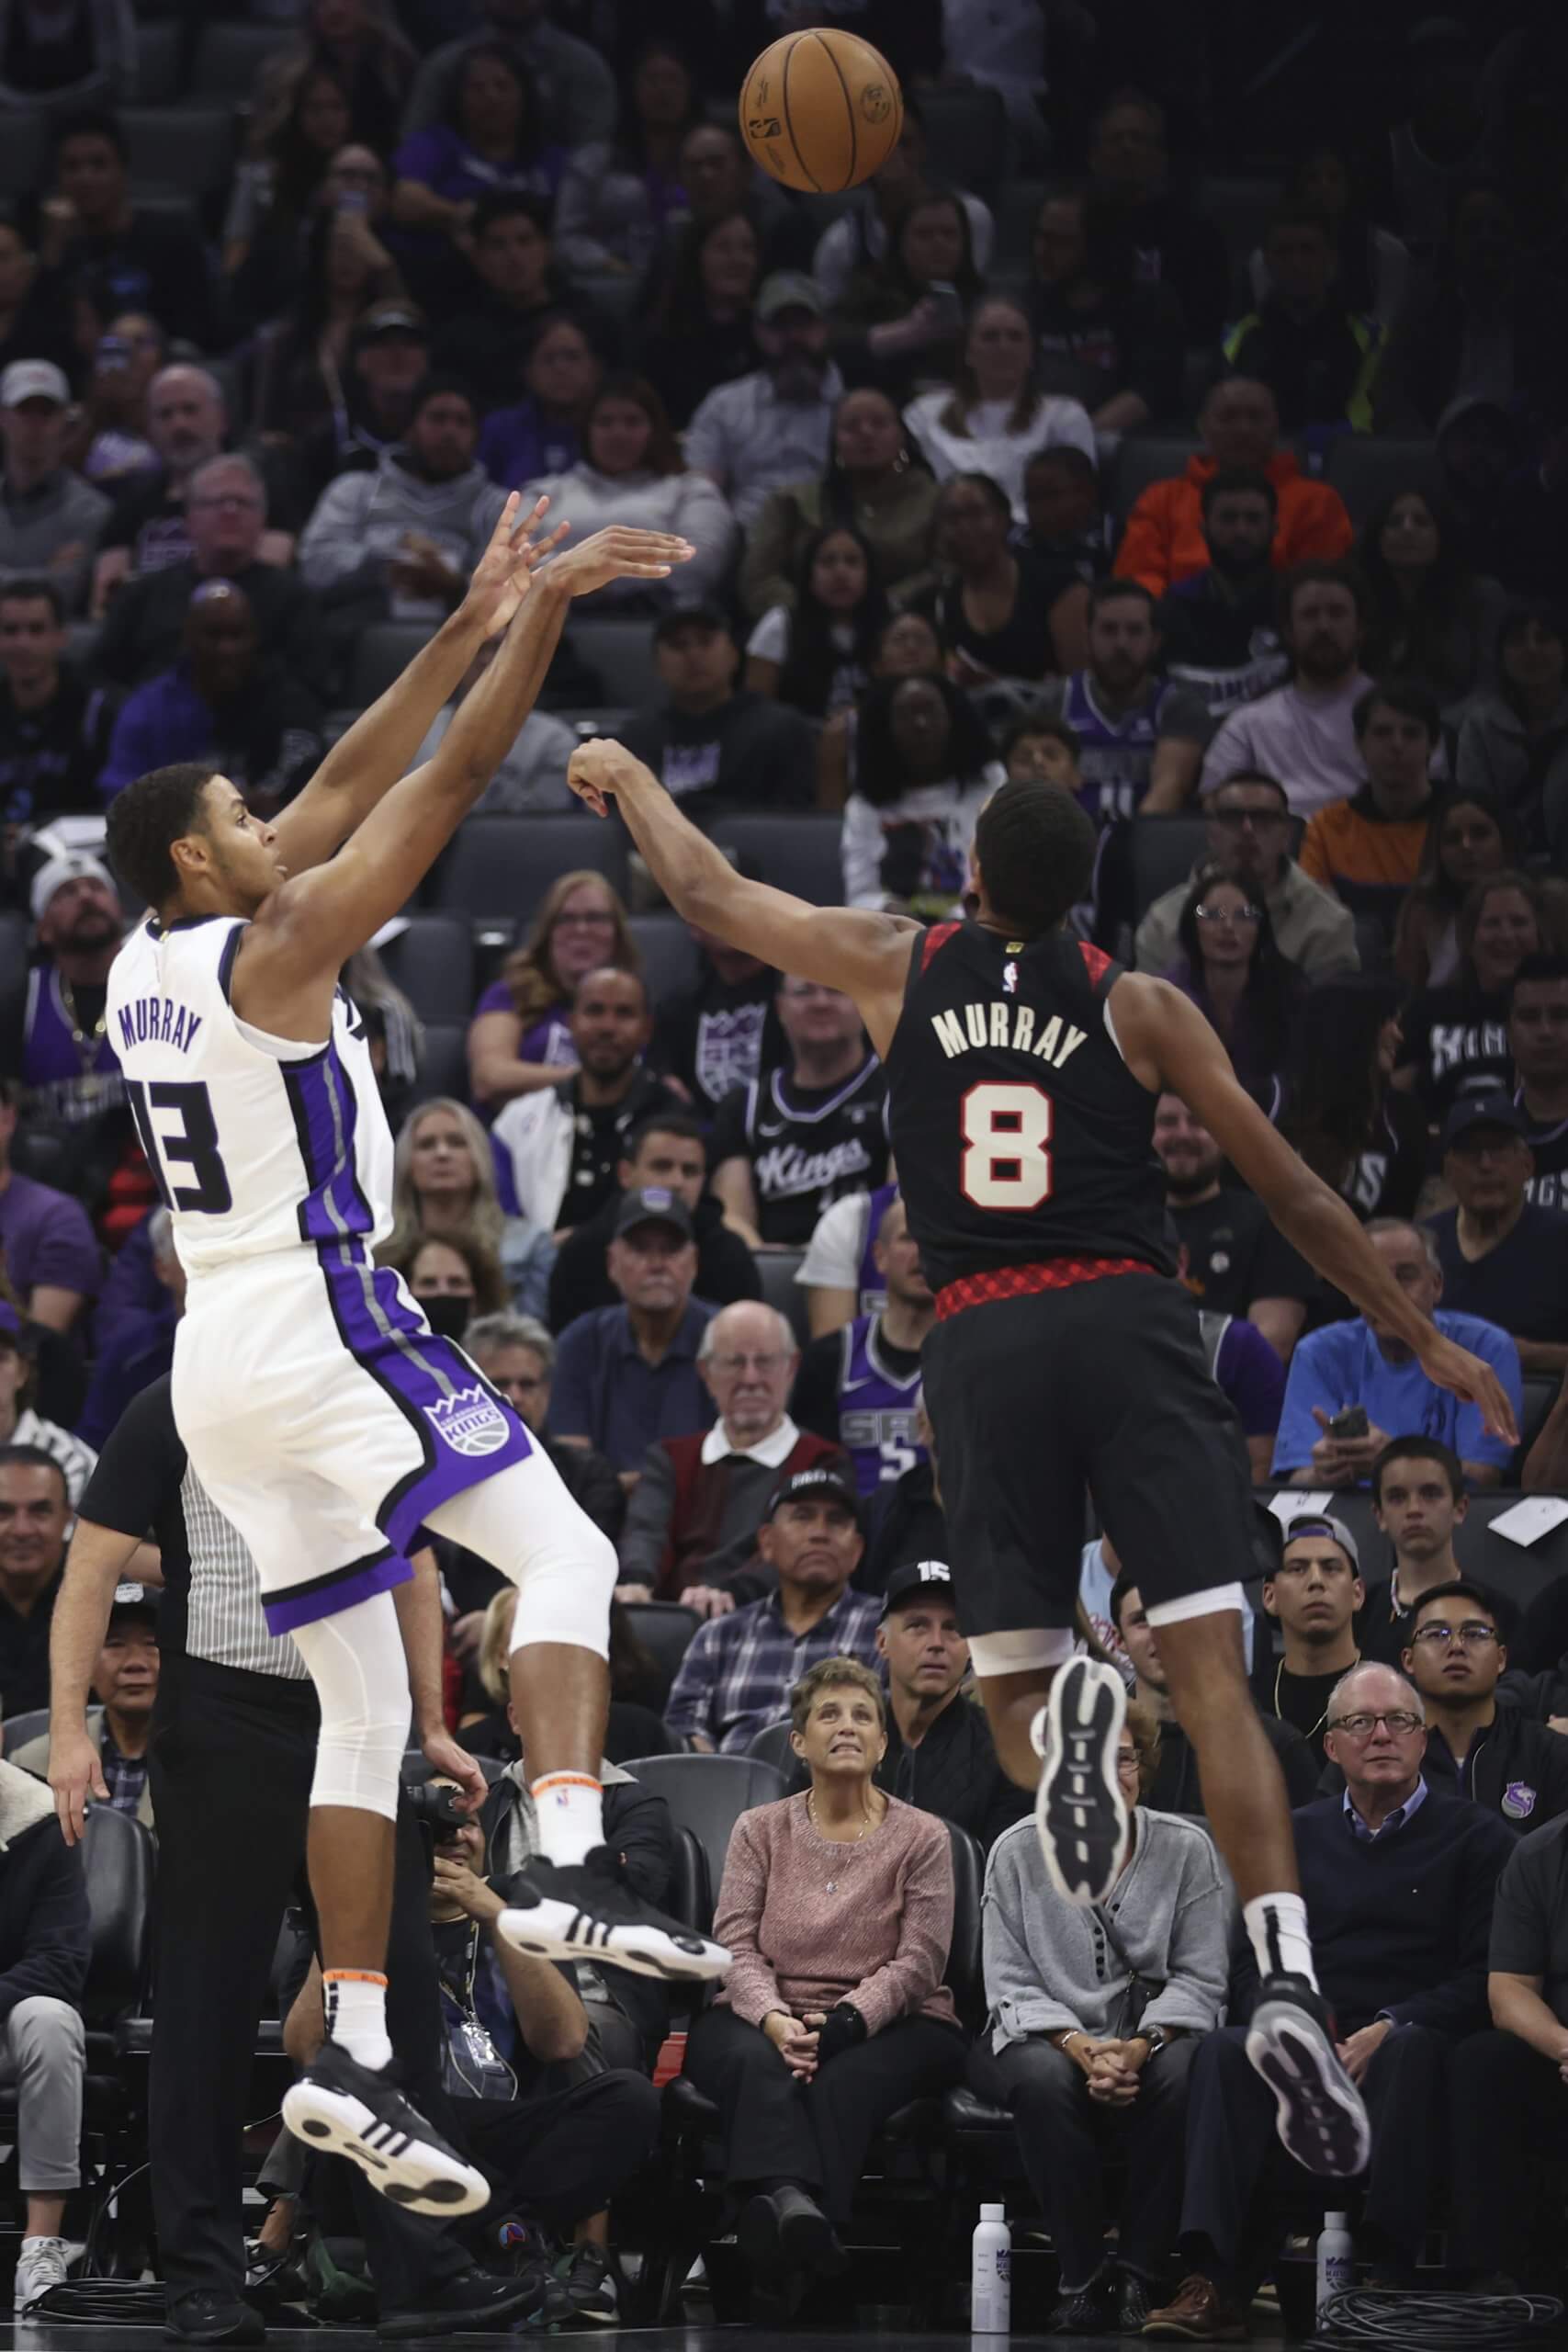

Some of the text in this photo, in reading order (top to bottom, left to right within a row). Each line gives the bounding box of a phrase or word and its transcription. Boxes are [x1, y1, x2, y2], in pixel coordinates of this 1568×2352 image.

[118, 997, 202, 1054] MURRAY
[931, 1001, 1089, 1069] MURRAY
[125, 1079, 233, 1215] 13
[754, 1136, 873, 1202] Kings
[958, 1079, 1055, 1214] 8
[445, 1408, 502, 1442] KINGS
[879, 1440, 917, 1481] 5
